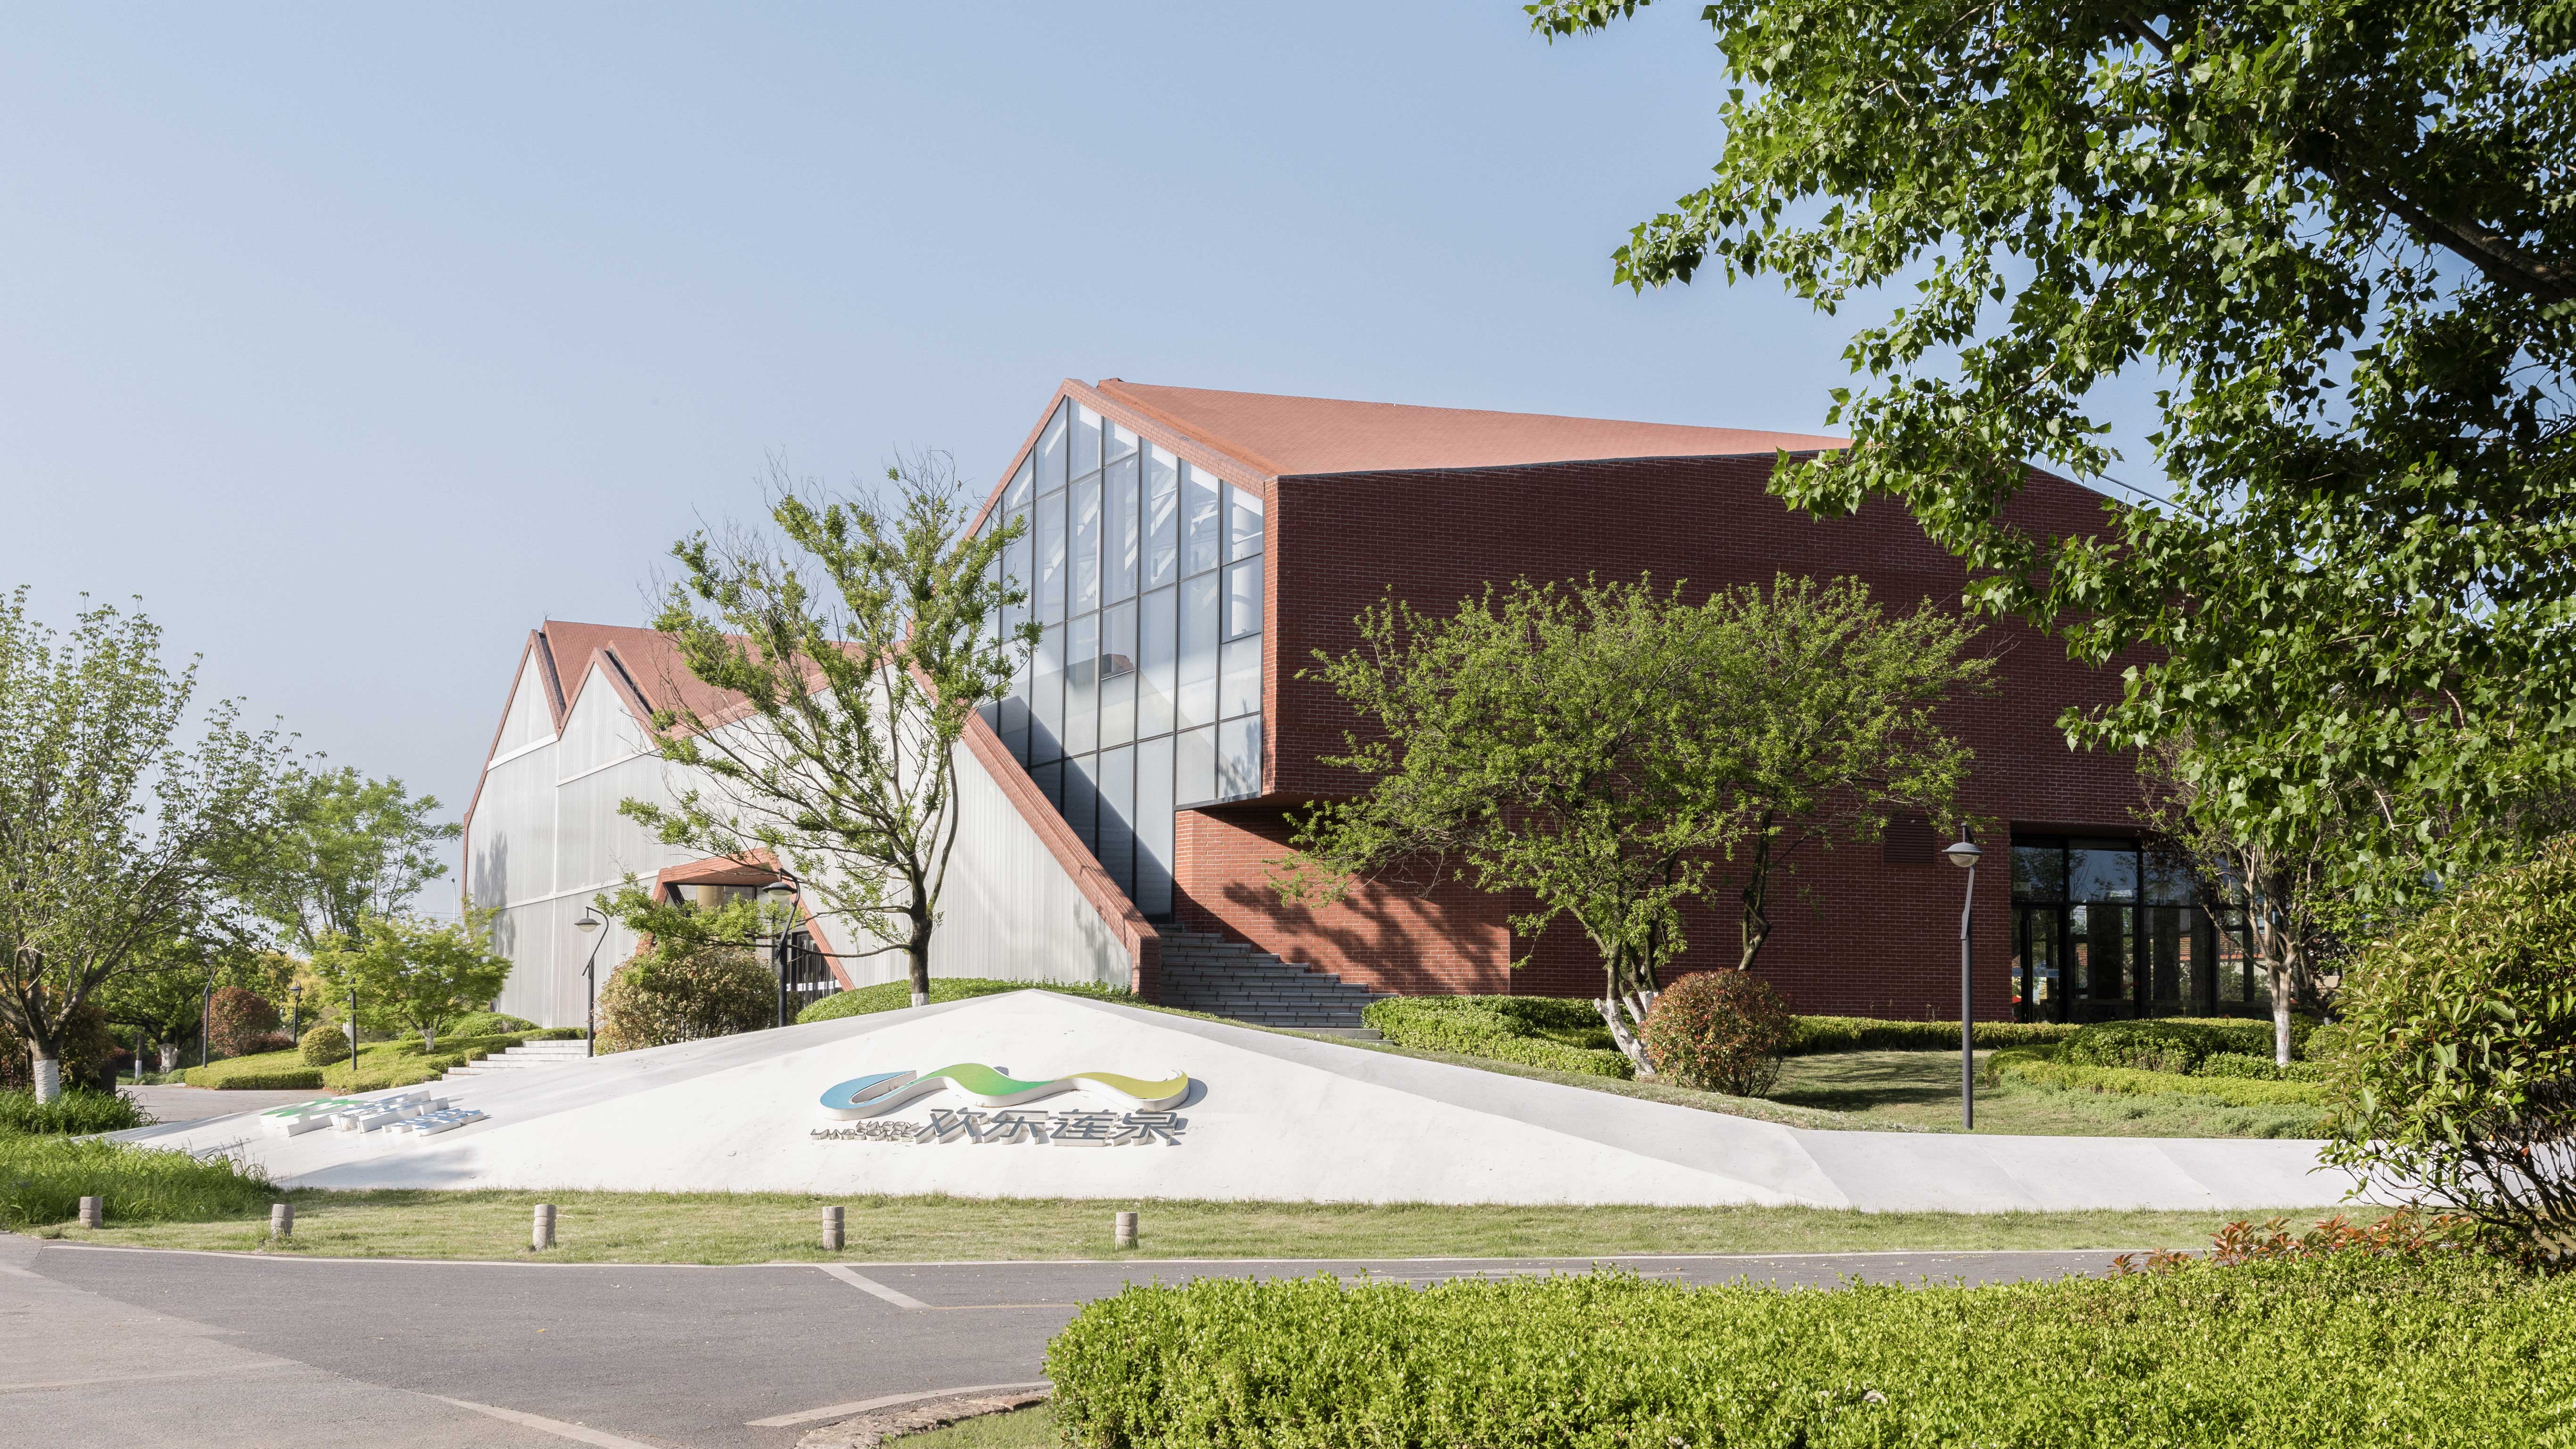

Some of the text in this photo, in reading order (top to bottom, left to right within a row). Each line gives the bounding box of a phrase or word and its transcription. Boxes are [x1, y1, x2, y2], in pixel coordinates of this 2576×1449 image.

[856, 1120, 919, 1130] HAPPY
[914, 1107, 1178, 1144] 欢乐莲泉
[810, 1128, 913, 1139] LANDSCAPE
